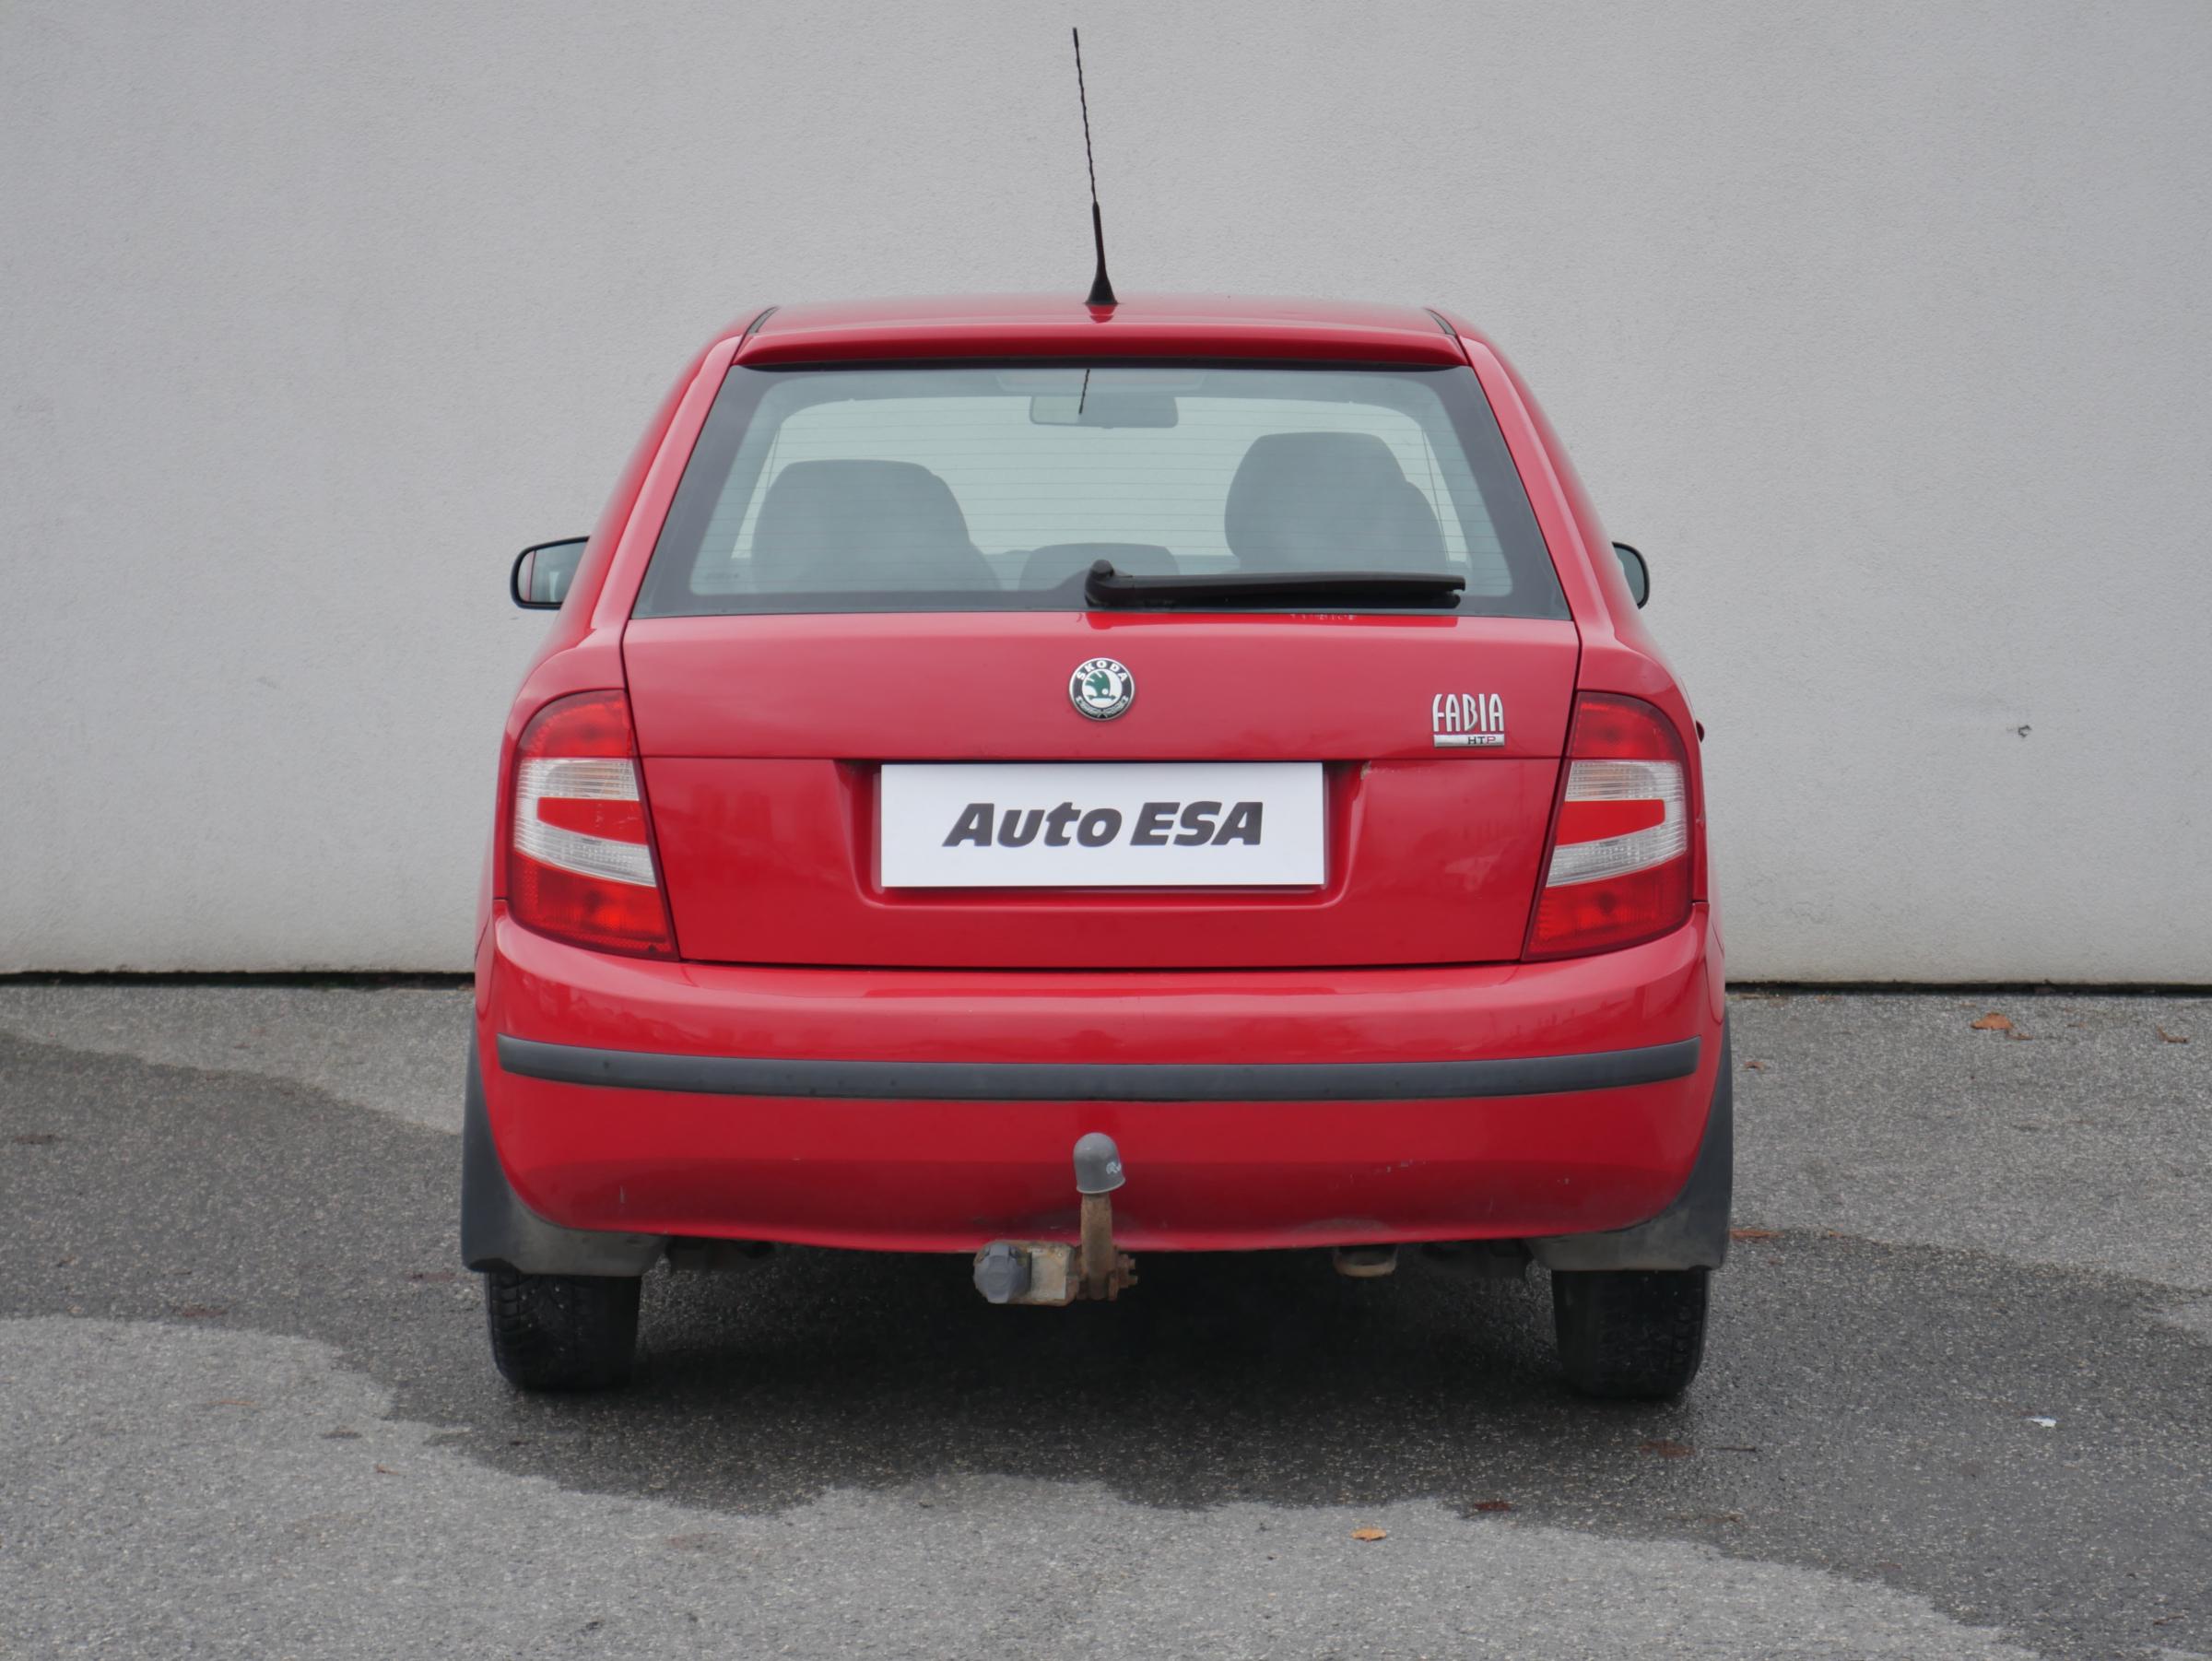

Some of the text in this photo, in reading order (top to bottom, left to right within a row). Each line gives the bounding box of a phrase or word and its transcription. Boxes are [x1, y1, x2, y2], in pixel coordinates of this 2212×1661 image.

[1077, 660, 1128, 682] SKODA
[1432, 693, 1504, 732] FABIA
[1467, 736, 1496, 745] HTP
[942, 801, 1264, 847] Auto ESA
